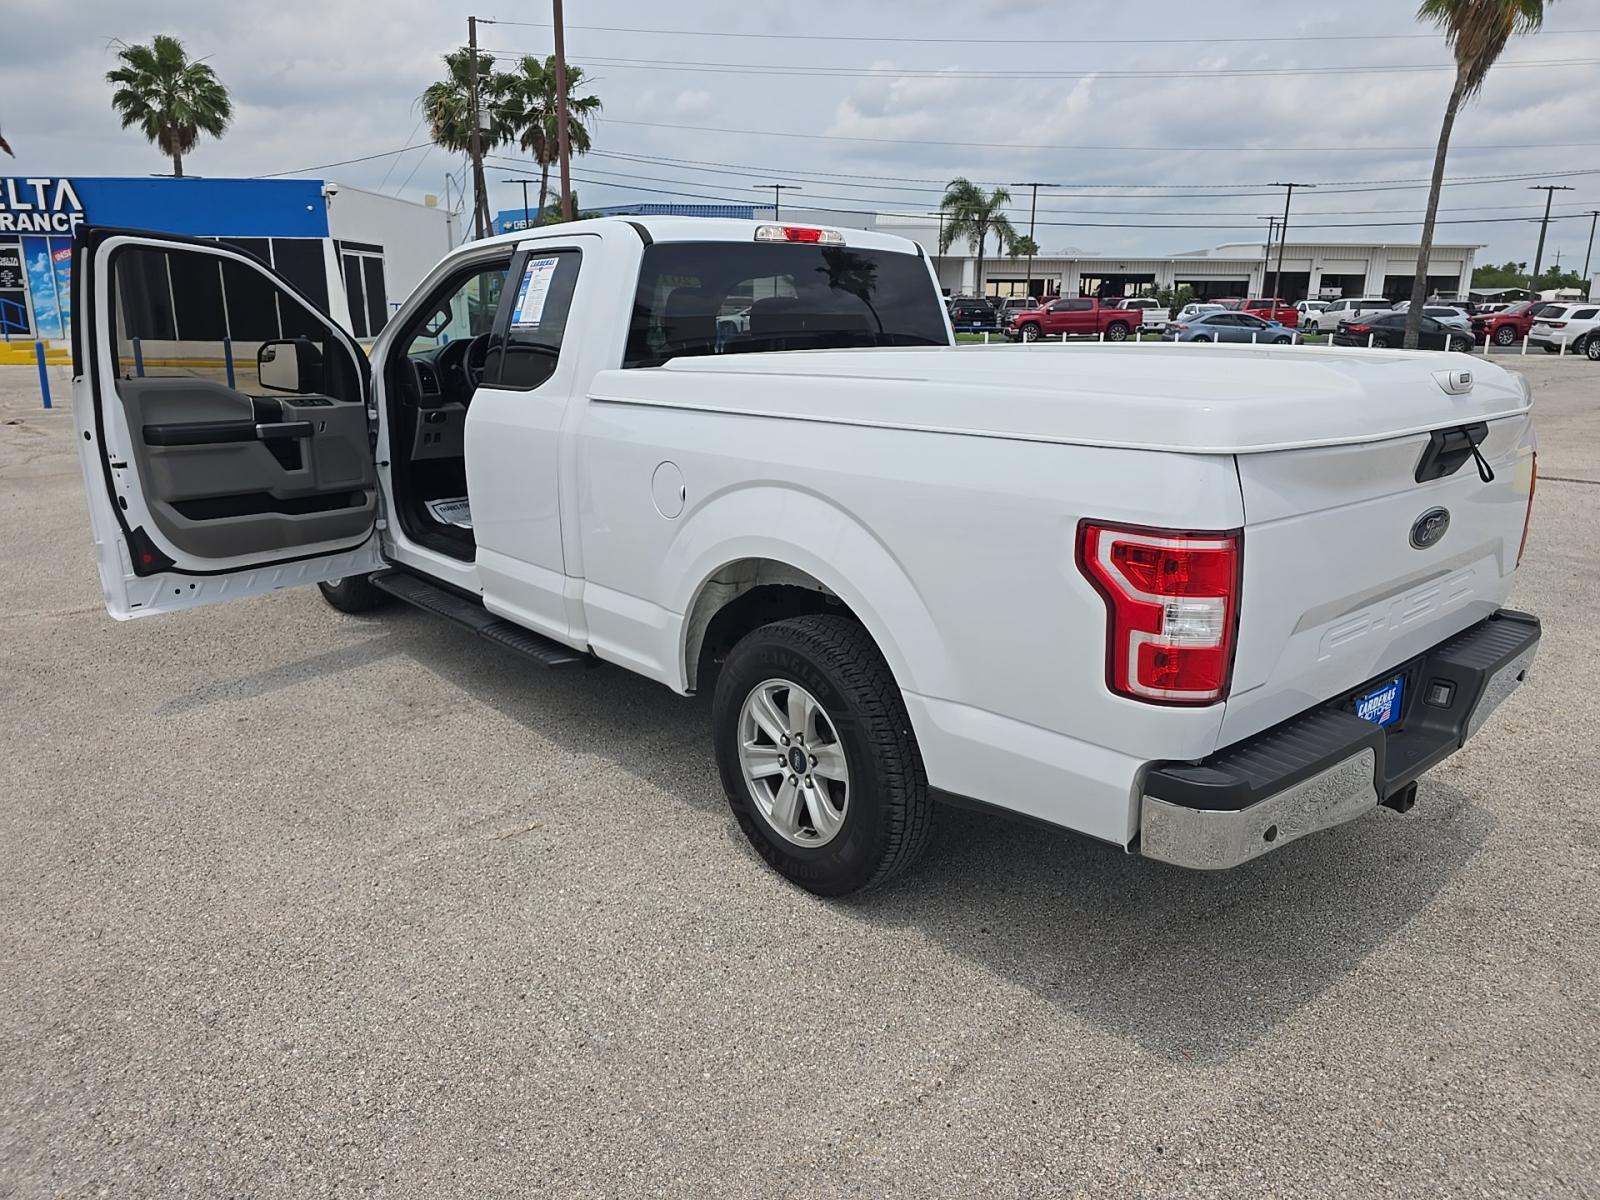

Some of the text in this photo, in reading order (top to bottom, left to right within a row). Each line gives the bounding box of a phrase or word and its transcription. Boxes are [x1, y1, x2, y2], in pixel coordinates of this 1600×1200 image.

[1420, 514, 1448, 543] Ford
[1358, 687, 1397, 717] CARDENAS
[1361, 700, 1392, 721] MOTORS
